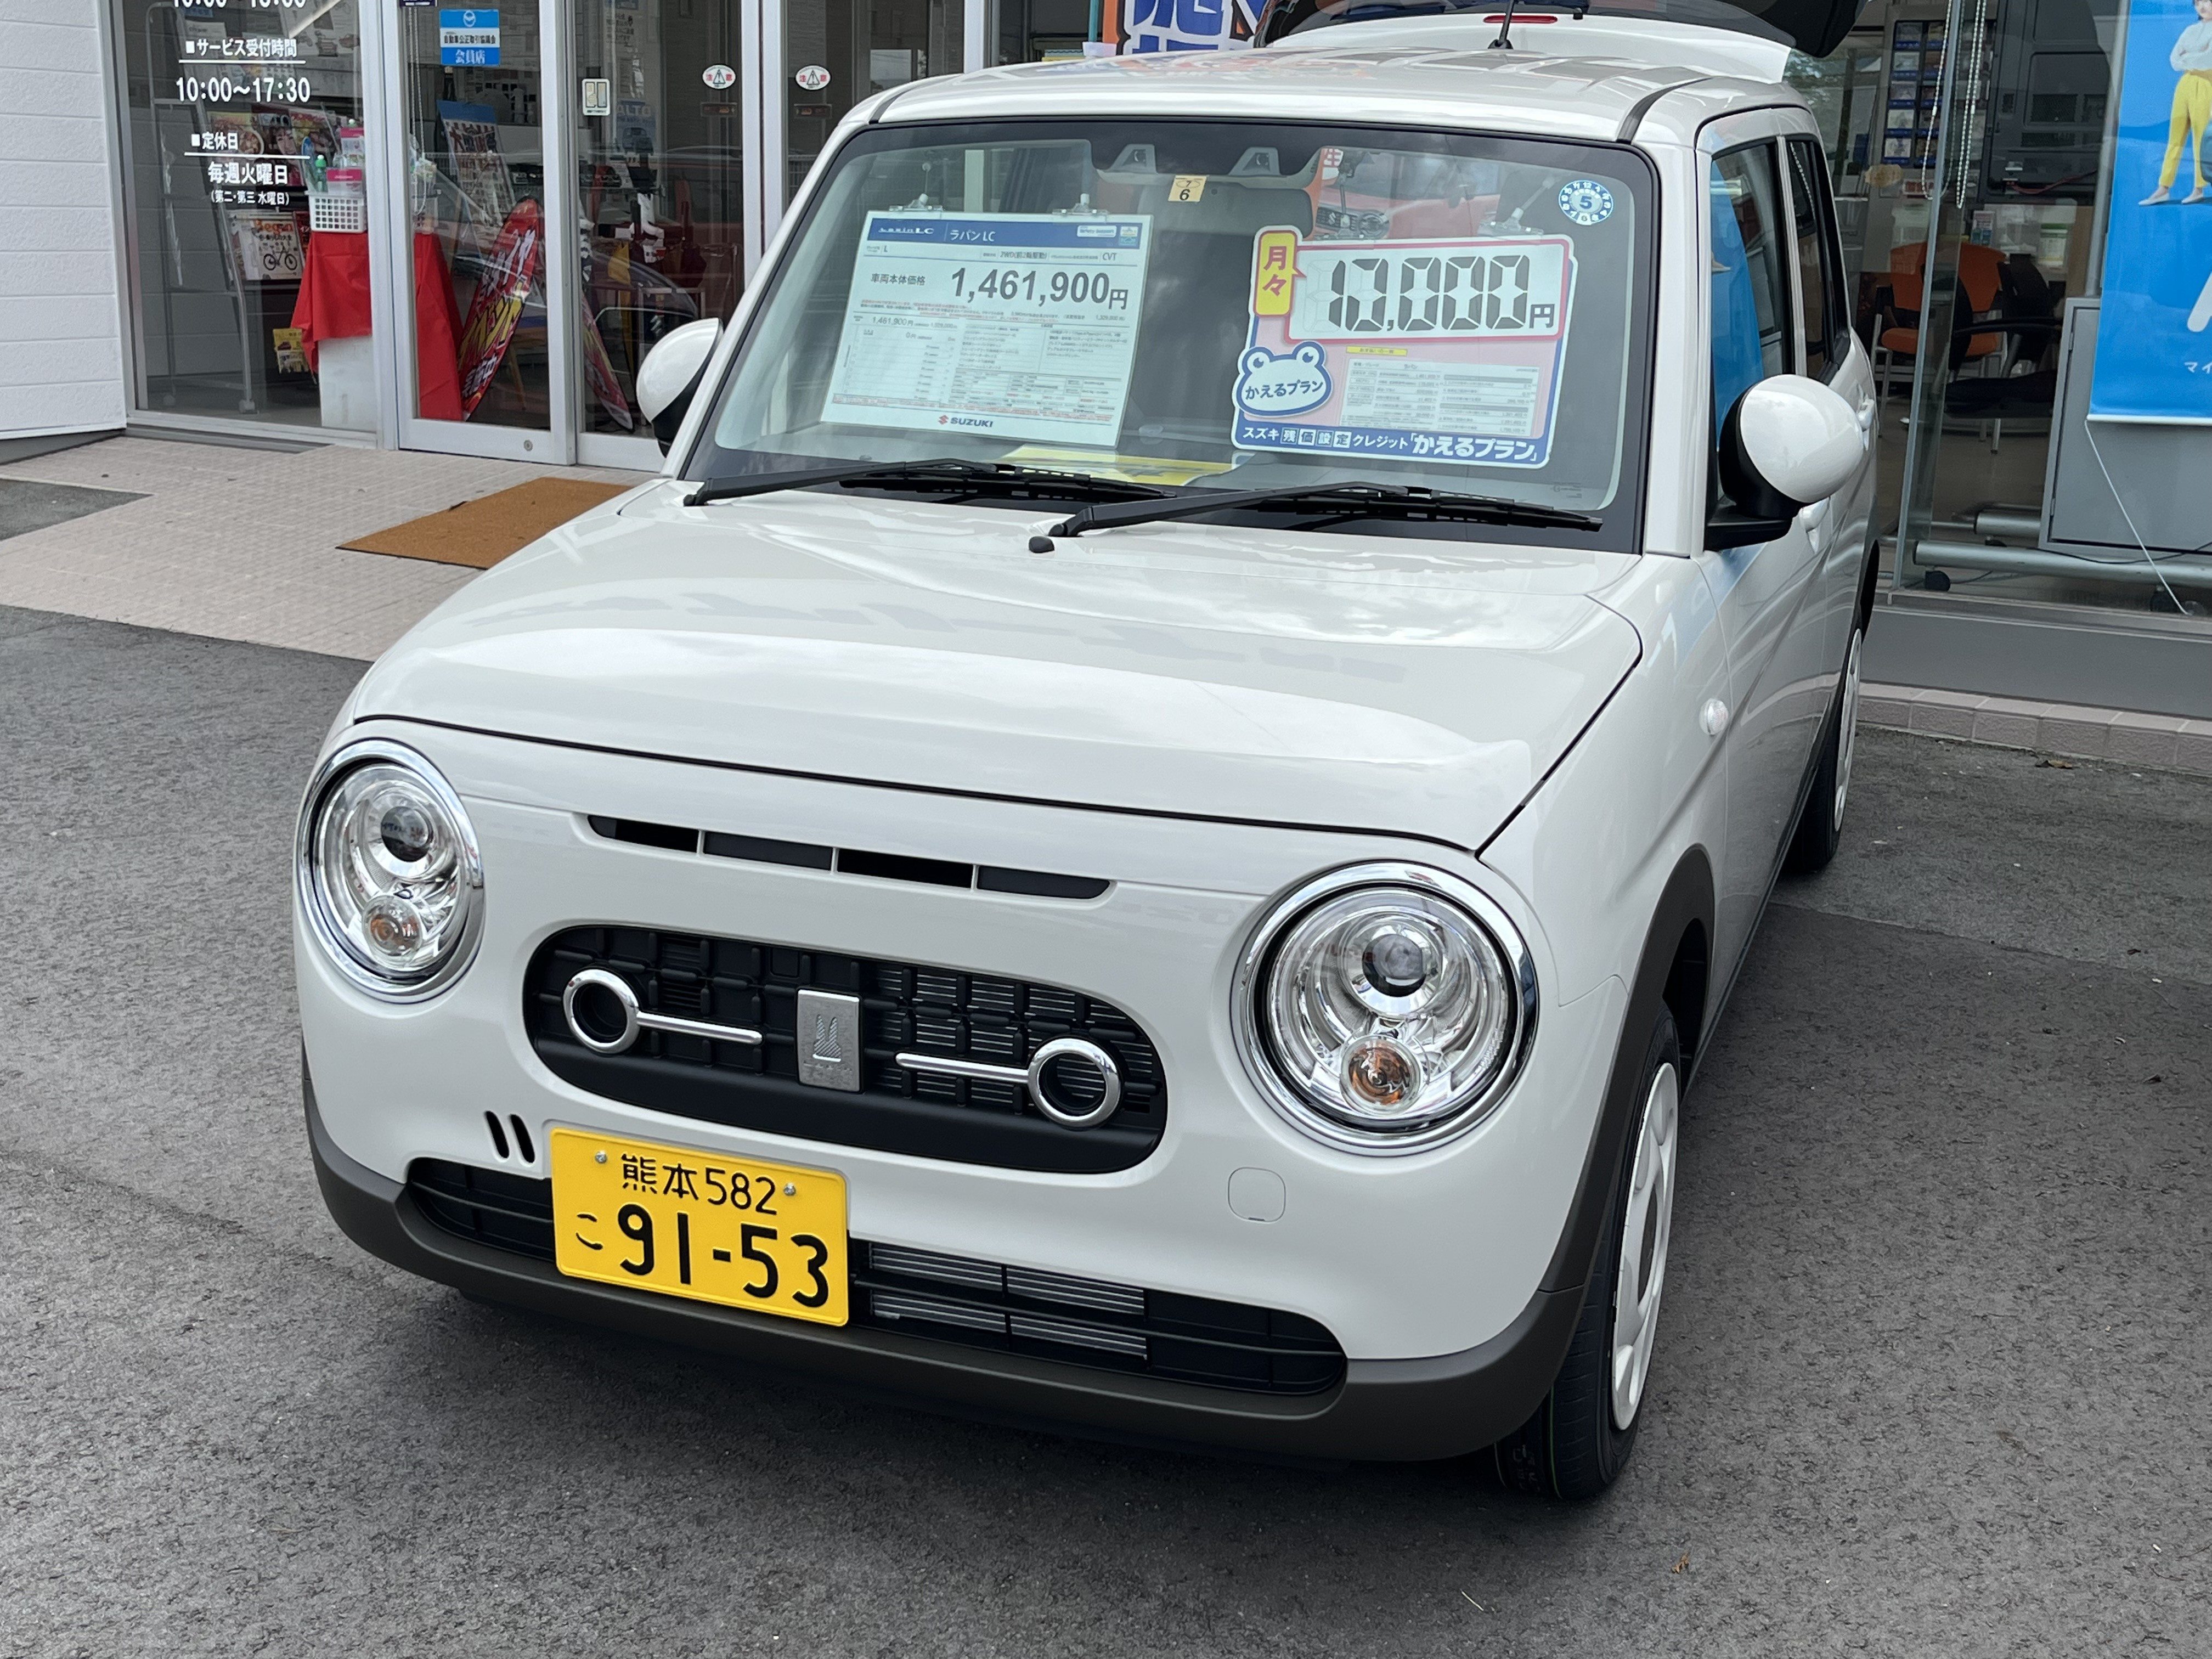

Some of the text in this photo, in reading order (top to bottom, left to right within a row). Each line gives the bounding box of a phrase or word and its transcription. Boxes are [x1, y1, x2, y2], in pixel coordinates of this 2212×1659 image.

[196, 38, 297, 57] サービス受付時間
[455, 49, 486, 65] 会員店
[201, 131, 239, 150] 定休日
[207, 161, 288, 185] 毎週火曜日
[1179, 189, 1190, 201] 6
[1579, 195, 1592, 209] 5
[950, 229, 996, 242] ラパン LC
[1102, 252, 1118, 261] CVT
[1263, 245, 1288, 296] 月々
[871, 273, 926, 286] 車両本体価格
[952, 267, 1129, 310] 1,461,900円
[1245, 379, 1324, 400] かえるプラン
[950, 417, 994, 427] SUZUKI
[575, 1203, 830, 1308] こ 91-53
